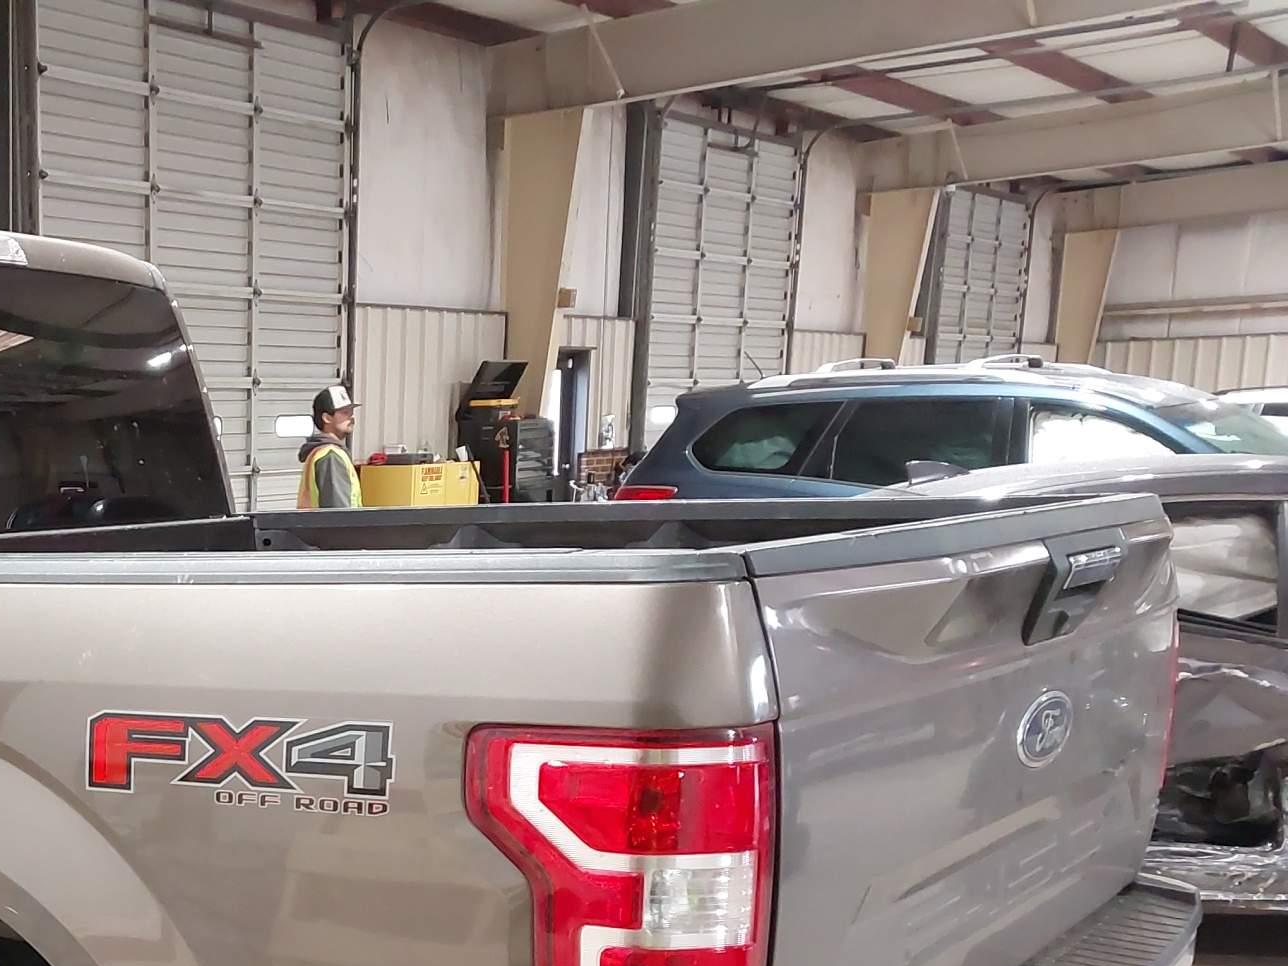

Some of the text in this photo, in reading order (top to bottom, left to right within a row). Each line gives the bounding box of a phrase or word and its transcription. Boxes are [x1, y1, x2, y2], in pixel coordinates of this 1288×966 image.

[86, 710, 396, 799] FX4
[215, 790, 391, 817] OFF ROAD
